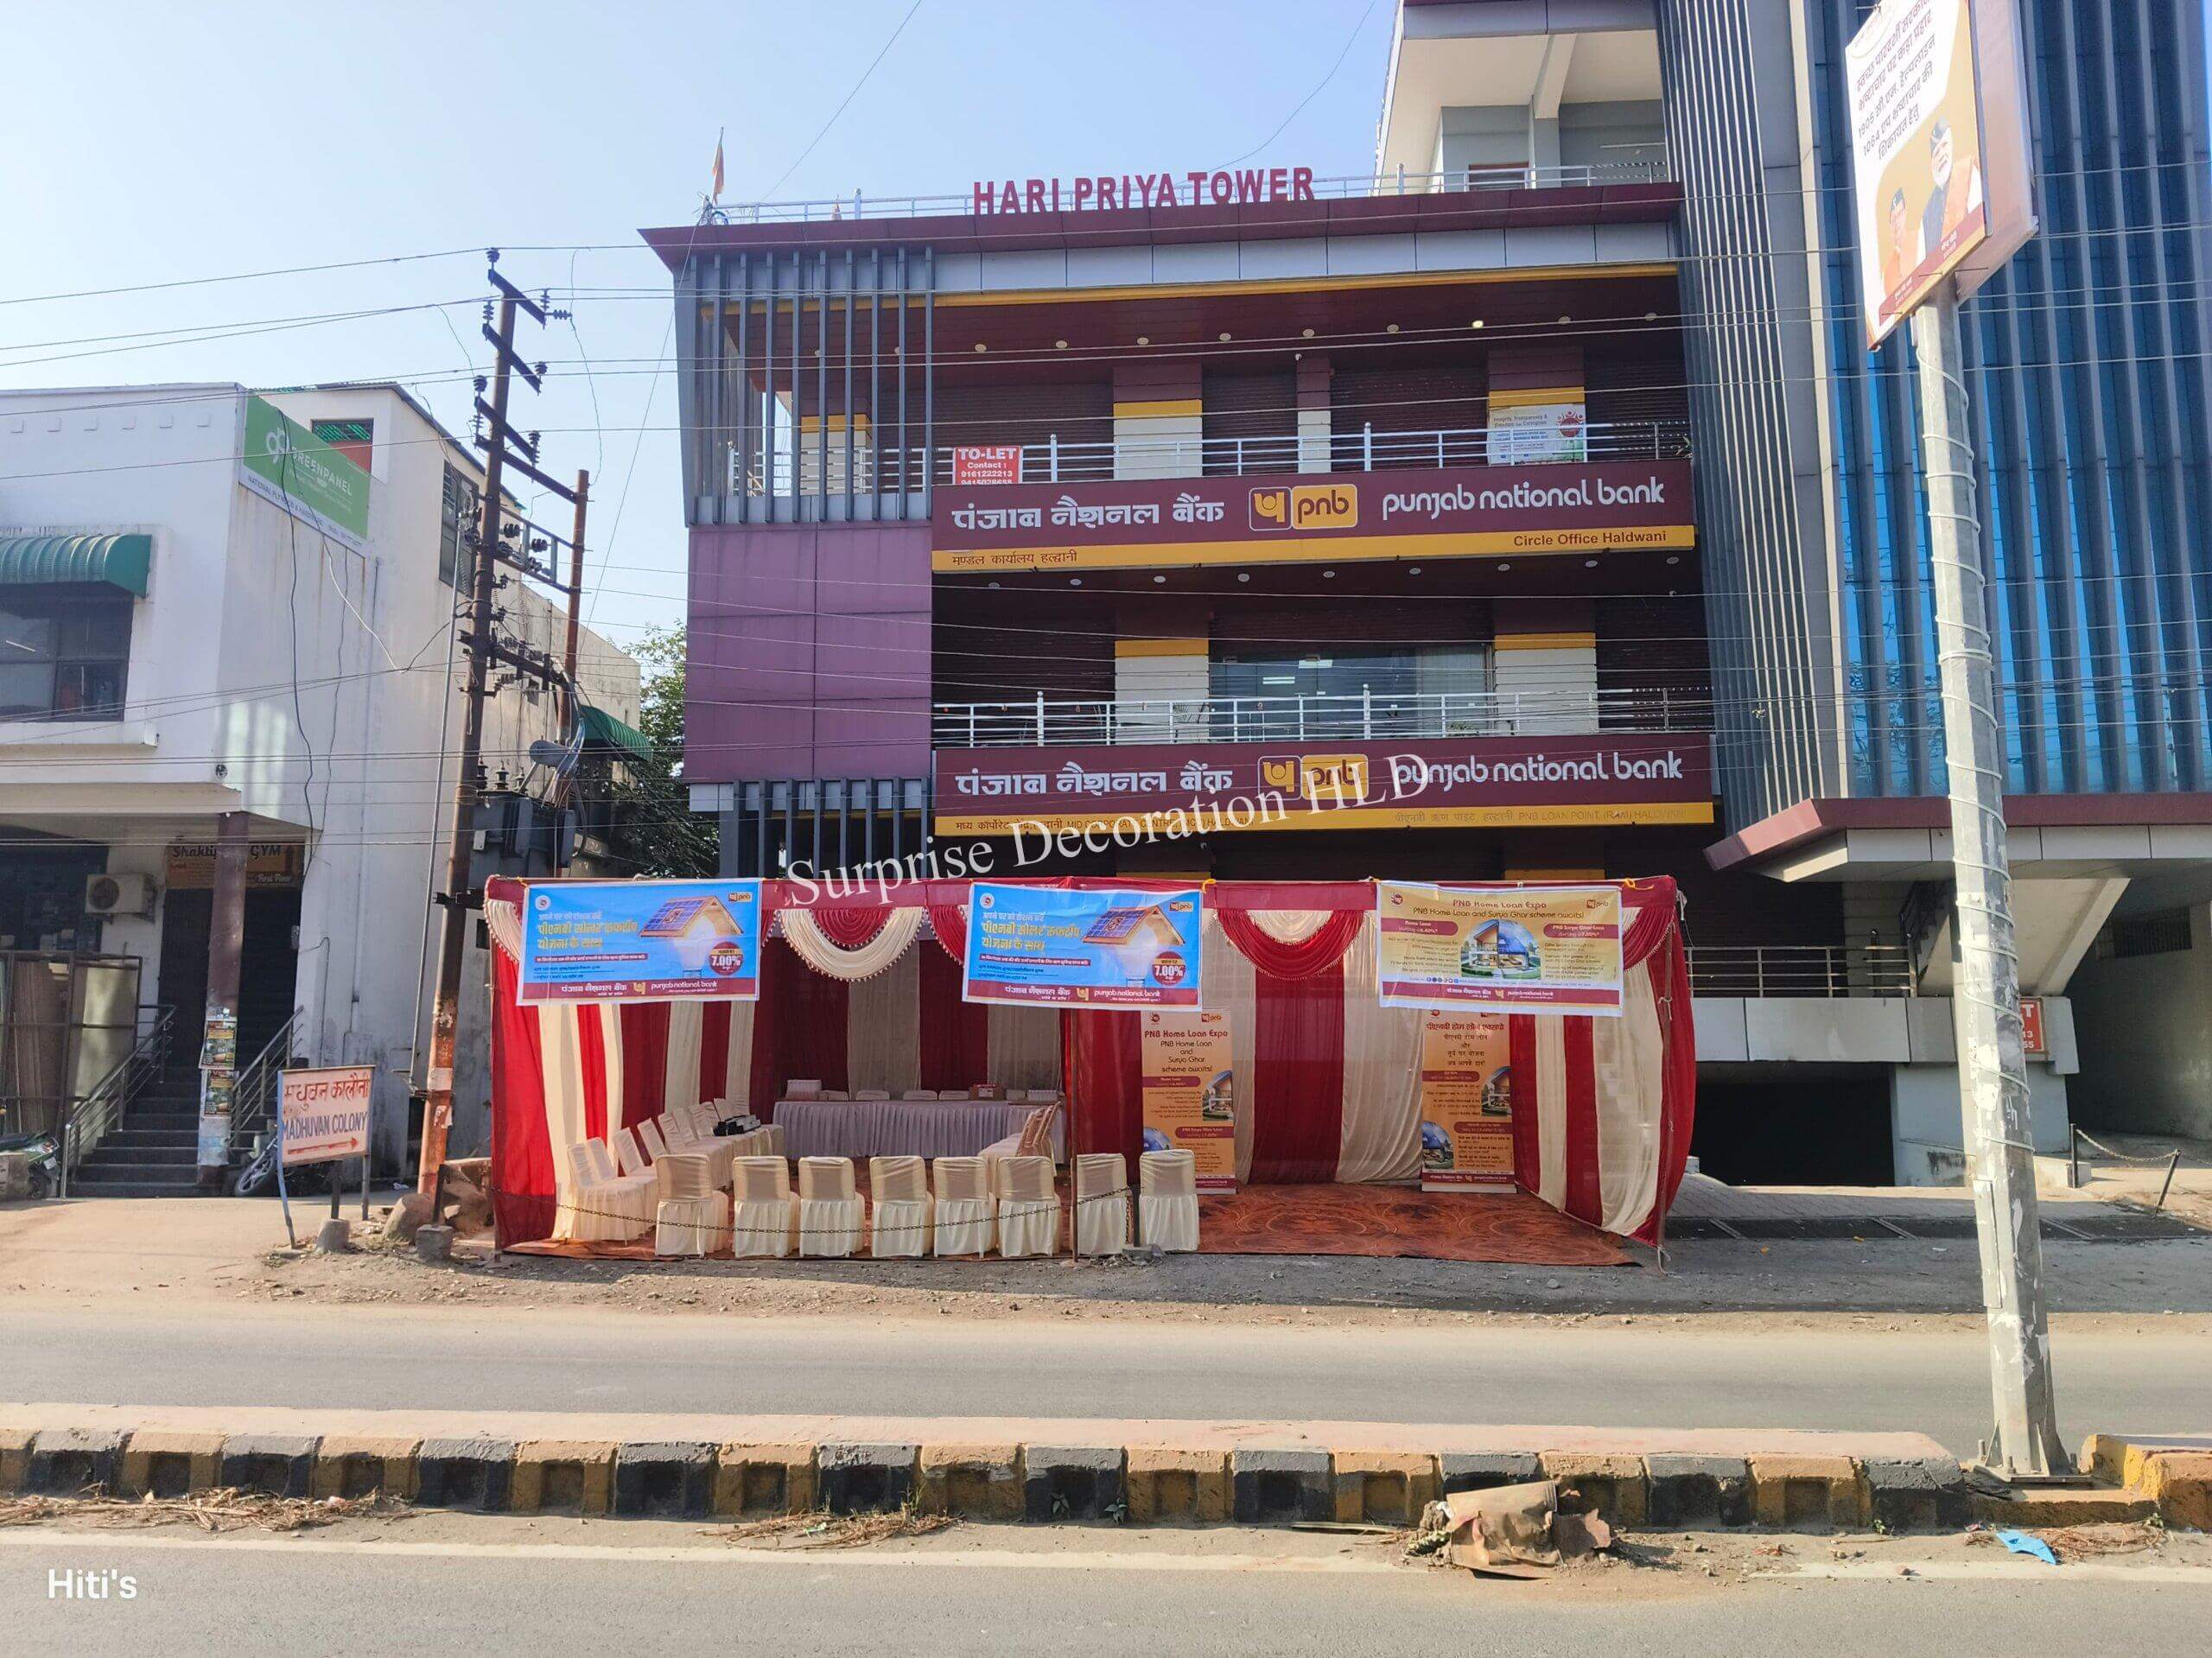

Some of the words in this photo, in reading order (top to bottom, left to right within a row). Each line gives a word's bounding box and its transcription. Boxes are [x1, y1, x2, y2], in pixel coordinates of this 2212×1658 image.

[1858, 112, 1874, 138] 1905
[974, 178, 1060, 215] HARI
[1074, 174, 1177, 213] PRIYA
[1187, 168, 1315, 206] TOWER
[958, 448, 1016, 460] TO-LET
[1298, 489, 1350, 524] pnb
[1382, 483, 1476, 520] punjab
[1479, 479, 1592, 510] national
[1598, 476, 1665, 505] bank
[952, 503, 1041, 530] पंजाब
[1051, 494, 1160, 529] नैशनल
[1173, 492, 1225, 523] बैंक
[1514, 534, 1553, 547] Circle
[1558, 531, 1599, 545] Office
[1602, 530, 1667, 544] Haldwani
[952, 556, 984, 565] मण्डल
[991, 550, 1034, 564] कार्यालय
[956, 768, 1046, 795] पंजाब
[1056, 761, 1166, 797] नैशनल
[1179, 759, 1233, 791] बैंक
[1395, 755, 1489, 792] punjab
[1493, 753, 1609, 783] national
[1613, 751, 1683, 779] bank
[1541, 811, 1568, 820] LOAN
[1571, 810, 1599, 820] POINT
[1526, 901, 1547, 910] Expo
[711, 955, 741, 966] 7.00%
[1154, 964, 1184, 976] 7.00%
[1209, 1029, 1228, 1039] Expo
[332, 1111, 368, 1134] COLONY
